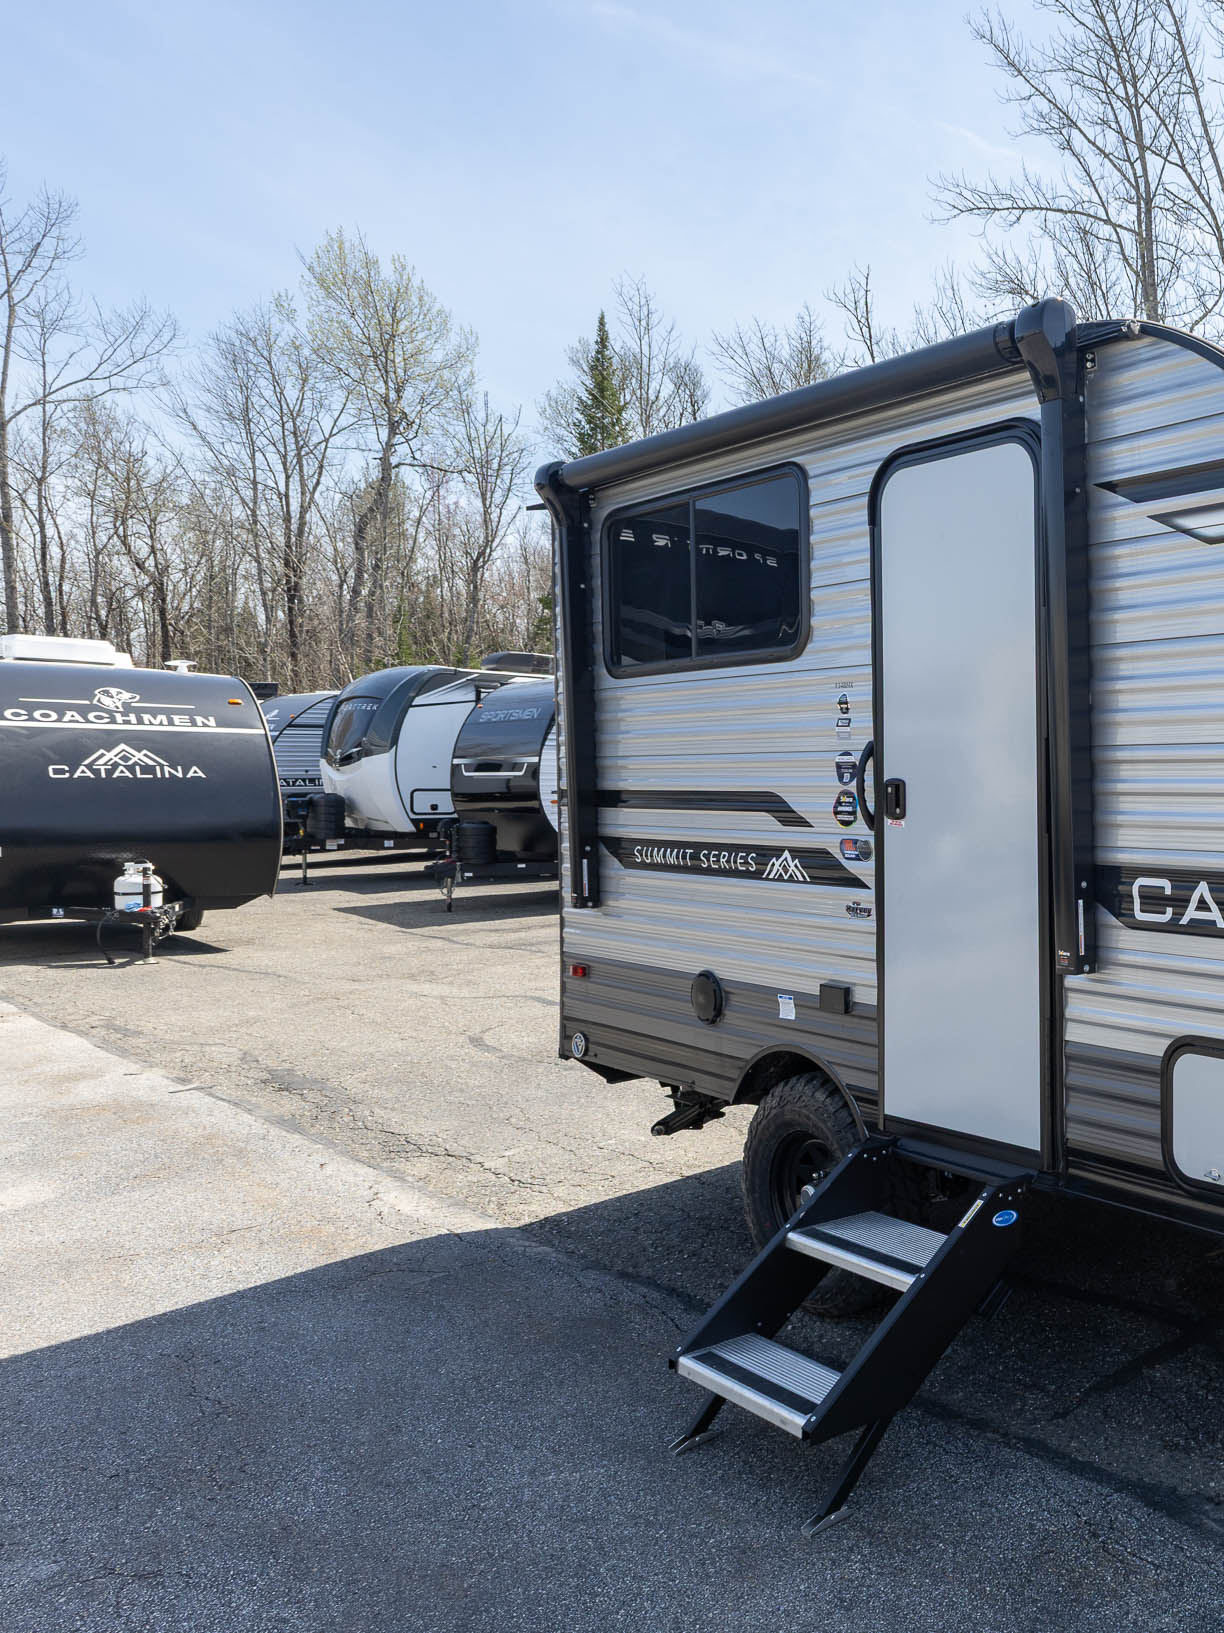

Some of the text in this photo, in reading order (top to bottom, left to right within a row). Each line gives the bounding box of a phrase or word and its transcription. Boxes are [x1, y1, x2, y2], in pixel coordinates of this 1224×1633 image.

[3, 708, 216, 727] COACHMEN
[47, 764, 207, 779] CATALINA
[633, 845, 757, 872] SUMMIT SERIES
